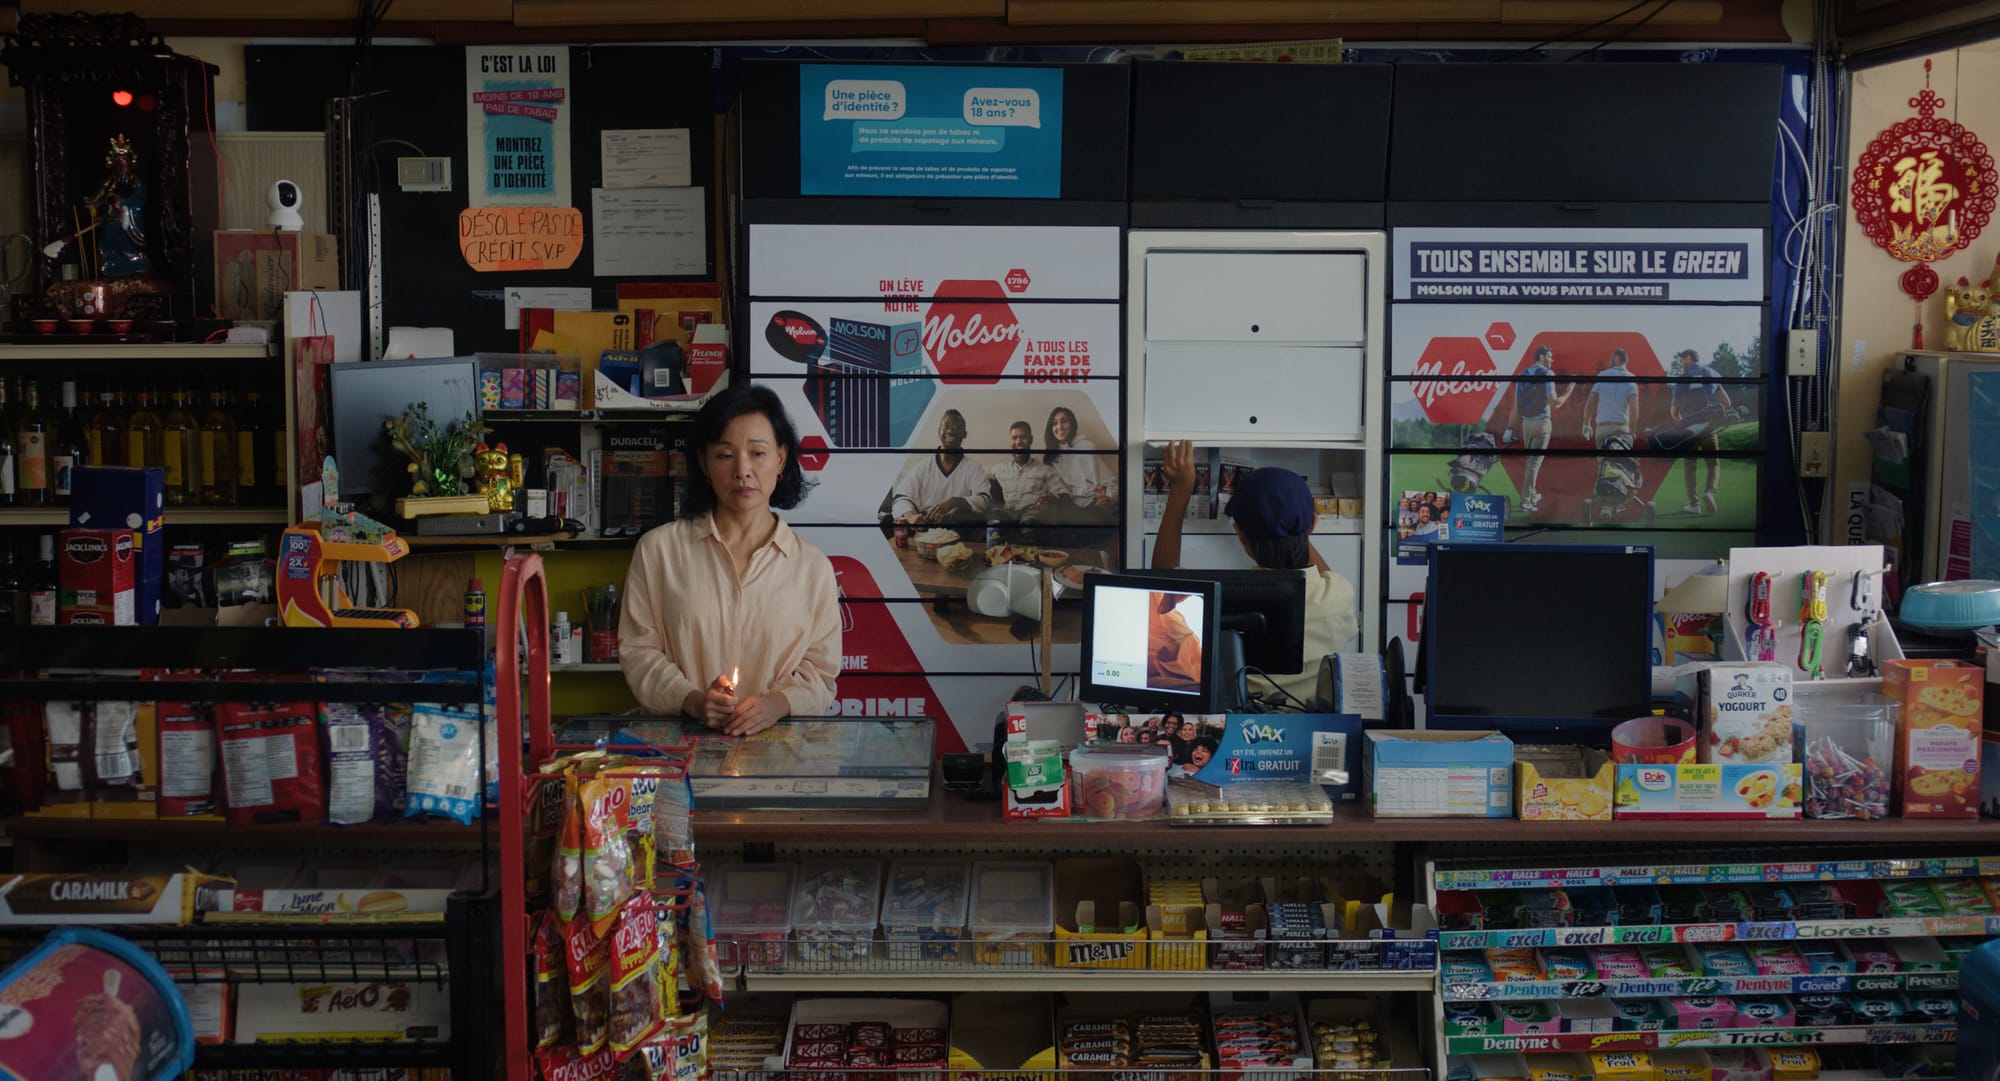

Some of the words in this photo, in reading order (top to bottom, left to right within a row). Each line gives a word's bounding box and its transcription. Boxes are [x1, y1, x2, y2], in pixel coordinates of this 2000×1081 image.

[481, 55, 513, 73] C'EST
[519, 55, 532, 73] LA
[538, 55, 556, 73] LOI
[475, 93, 507, 102] MOINS
[510, 91, 523, 100] DE
[527, 91, 539, 99] 18
[542, 89, 563, 98] ANS
[832, 90, 855, 100] Une
[858, 90, 891, 102] pièce
[832, 100, 890, 112] d'identité
[971, 97, 1031, 107] Avez-vous
[485, 103, 504, 113] PAS
[507, 105, 520, 114] DE
[524, 106, 556, 118] TABAC
[971, 108, 983, 117] 18
[986, 110, 1006, 118] ans
[859, 127, 877, 135] Nous
[890, 128, 922, 136] vendons
[923, 129, 937, 137] pas
[938, 128, 948, 136] de
[973, 128, 980, 136] ni
[496, 137, 542, 152] MONTREZ
[859, 136, 869, 144] de
[870, 136, 901, 145] produits
[914, 138, 950, 146] vapotage
[494, 155, 513, 170] UNE
[518, 152, 545, 170] PIÈCE
[493, 171, 546, 188] D'IDENTITÉ
[1888, 151, 1960, 225] 福
[460, 208, 526, 237] DÉSOLÉ
[532, 210, 562, 236] PAS
[1417, 249, 1473, 273] TOUS
[1479, 249, 1588, 274] ENSEMBLE
[1593, 250, 1636, 274] SUR
[1642, 250, 1667, 274] LE
[1672, 250, 1742, 274] GREEN
[879, 280, 894, 292] ON
[897, 277, 924, 292] LÈVE
[1007, 277, 1029, 285] 1786
[1417, 285, 1473, 296] MOLSON
[1475, 285, 1519, 296] ULTRA
[1521, 285, 1558, 296] VOUS
[1561, 286, 1593, 296] PAYE
[1596, 286, 1614, 296] LA
[1616, 286, 1663, 296] PARTIE
[884, 294, 919, 313] NOTRE
[834, 321, 887, 341] MOLSON
[922, 313, 1023, 362] Molson
[1026, 338, 1034, 353] À
[1037, 341, 1066, 353] TOUS
[1068, 341, 1088, 353] LES
[1024, 355, 1065, 366] FANS
[1070, 355, 1090, 366] DE
[1024, 368, 1090, 384] HOCKEY
[1409, 360, 1501, 409] Molson
[610, 437, 656, 446] DURACELL
[1727, 691, 1757, 699] QUAKER
[1774, 688, 1786, 698] 40
[1718, 702, 1767, 712] YOGOURT
[1242, 724, 1286, 745] MAX
[1258, 760, 1300, 771] GRATUIT
[1644, 771, 1665, 781] Dole
[1512, 871, 1540, 880] HALLS
[1566, 869, 1594, 878] HALLS
[1620, 868, 1648, 876] HALLS
[1674, 867, 1703, 875] HALLS
[51, 881, 129, 900] CARAMILK
[1564, 928, 1605, 944] excel
[1622, 927, 1662, 942] excel
[1746, 922, 1786, 938] excel
[1796, 925, 1891, 937] Clorets
[1449, 932, 1489, 947] excel
[1506, 930, 1545, 946] excel
[1503, 984, 1558, 996] Dentyne
[1619, 982, 1674, 994] Dentyne
[1736, 979, 1790, 991] Dentyne
[1800, 980, 1841, 991] Clorets
[1856, 979, 1899, 990] Clorets
[1073, 1024, 1118, 1032] CARAMILK
[1074, 1040, 1118, 1050] CARAMILK
[1483, 1037, 1549, 1052] Dentyne
[1071, 1053, 1117, 1062] CARAMILK
